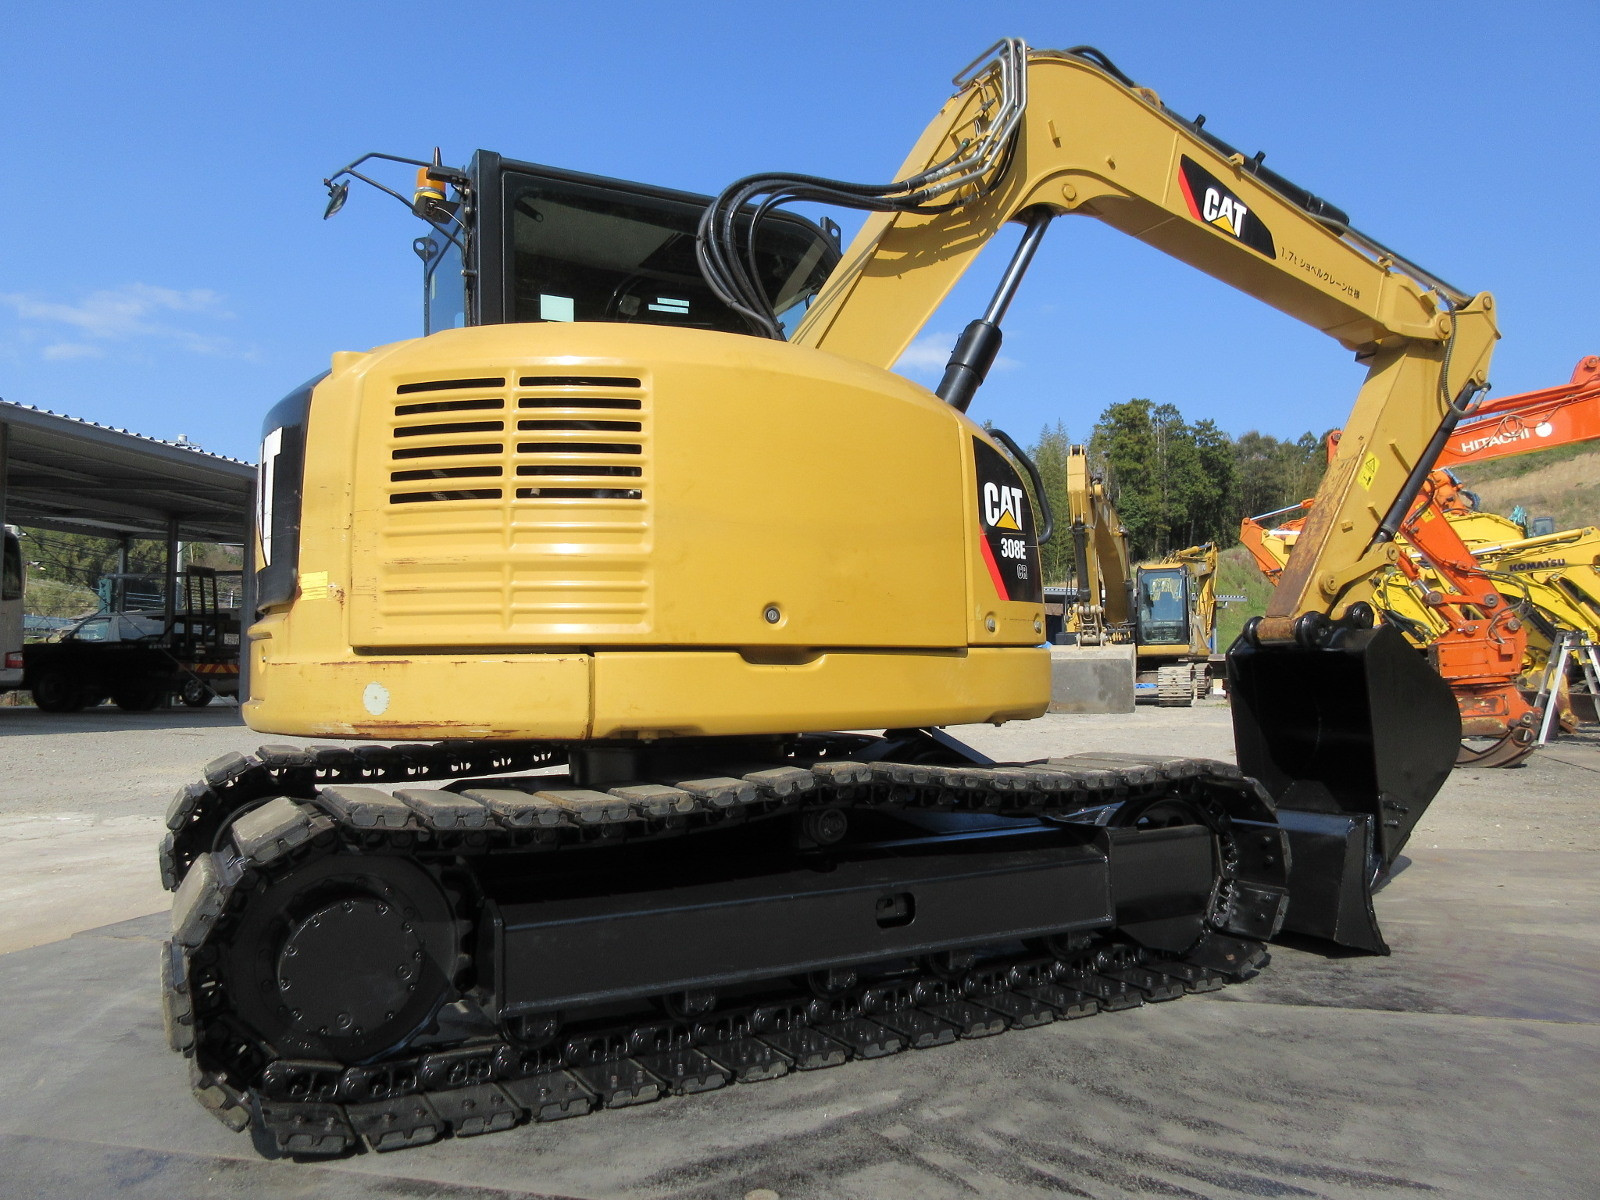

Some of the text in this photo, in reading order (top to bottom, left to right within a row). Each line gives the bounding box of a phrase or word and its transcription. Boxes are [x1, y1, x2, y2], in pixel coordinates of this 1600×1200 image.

[1203, 187, 1247, 237] CAT
[1281, 247, 1297, 265] 1.7t
[1461, 428, 1530, 452] HITACHI
[983, 481, 1023, 531] CAT
[1001, 538, 1026, 560] 308E
[1016, 563, 1028, 580] CR
[1509, 558, 1566, 572] KOMATSU
